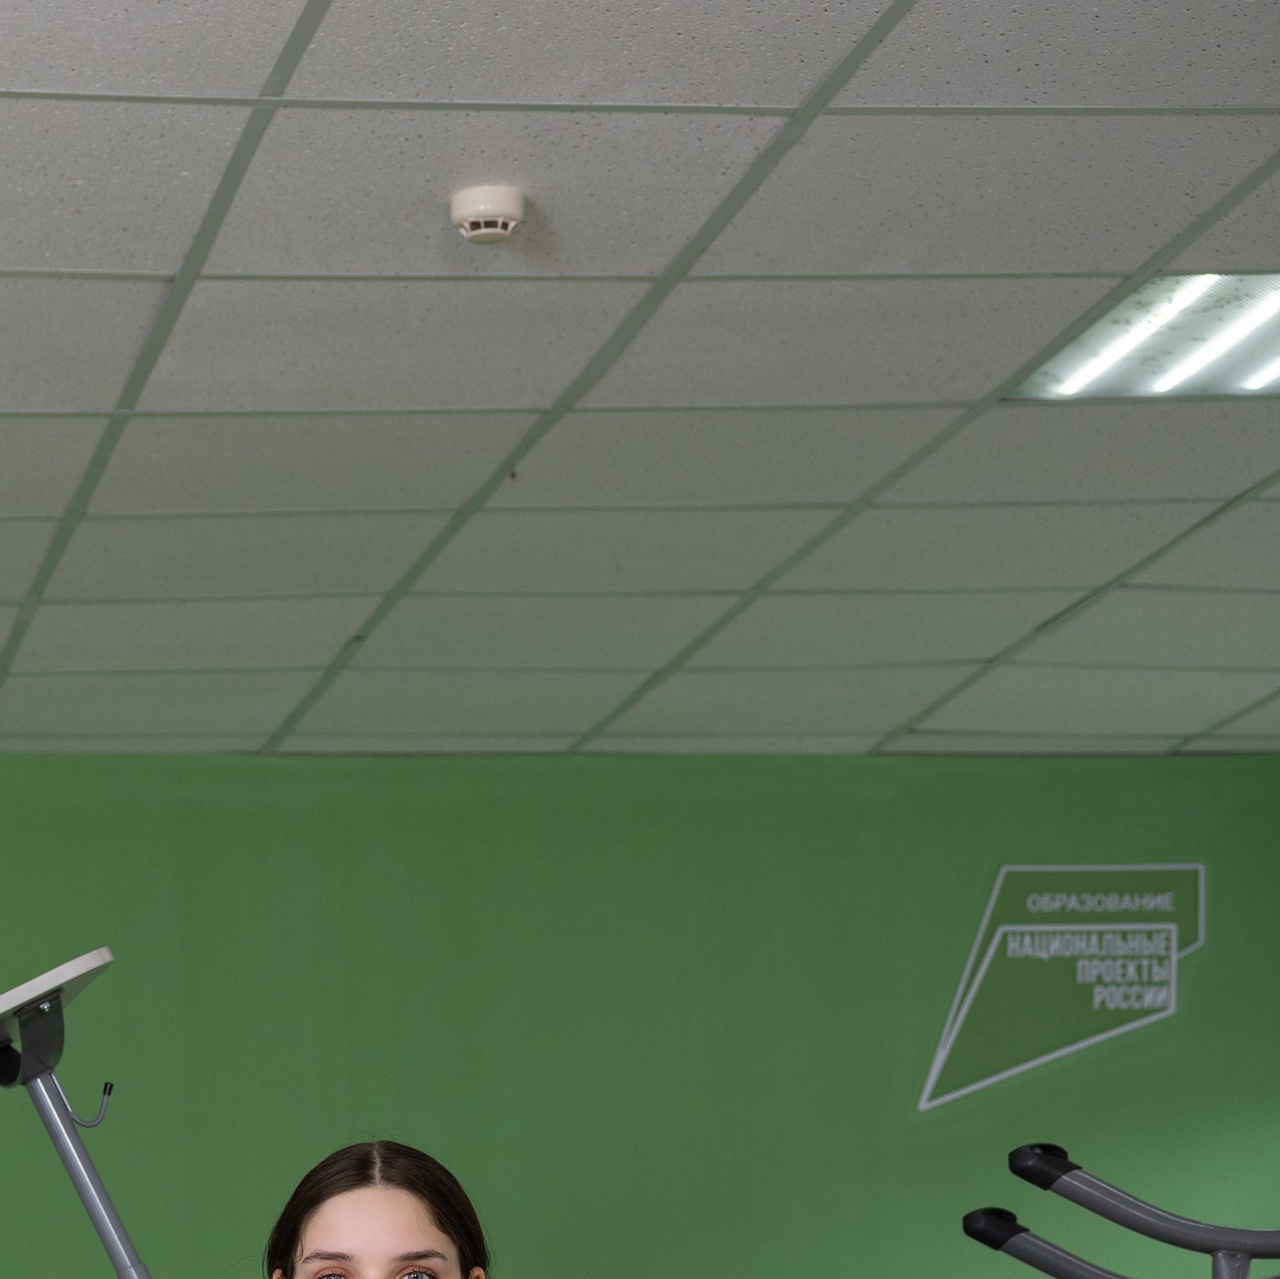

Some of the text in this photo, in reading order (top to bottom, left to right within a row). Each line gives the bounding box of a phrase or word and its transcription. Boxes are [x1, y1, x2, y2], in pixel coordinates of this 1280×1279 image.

[1026, 892, 1175, 912] ОБРАЗОВАНИЕ
[1006, 932, 1170, 960] НАЦИОНАЛЬНЫЕ
[1077, 959, 1170, 984] ПРОЕКТЫ
[1093, 985, 1169, 1010] РОССИИ
